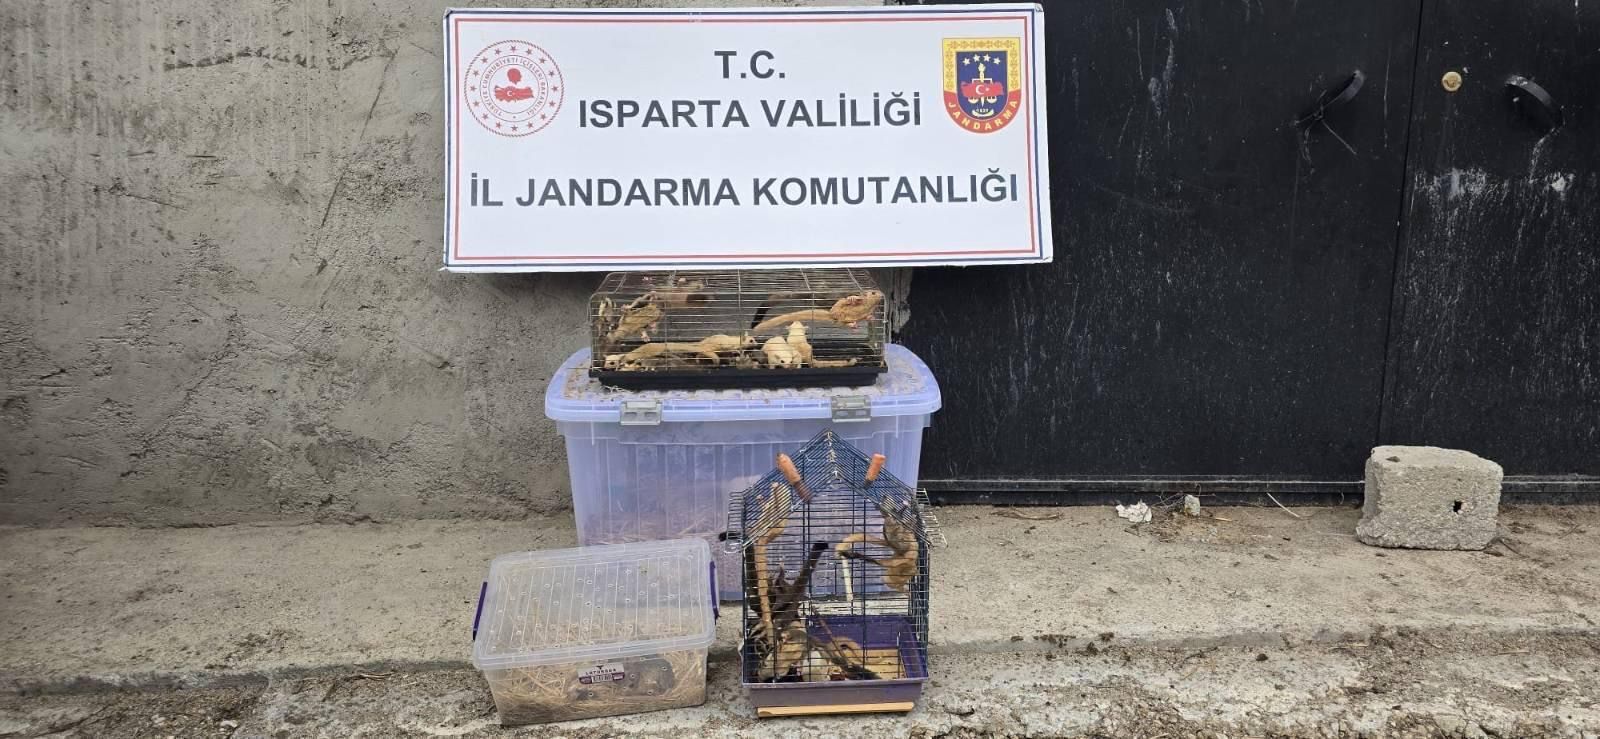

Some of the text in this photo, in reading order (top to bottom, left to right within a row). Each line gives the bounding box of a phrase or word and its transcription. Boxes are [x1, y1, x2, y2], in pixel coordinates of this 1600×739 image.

[714, 50, 786, 79] T.C.
[579, 91, 921, 129] ISPARTA VALİLİĞİ
[948, 100, 1018, 131] JANDARMA
[470, 167, 1018, 207] İL JANDARMA KOMUTANLIĞI
